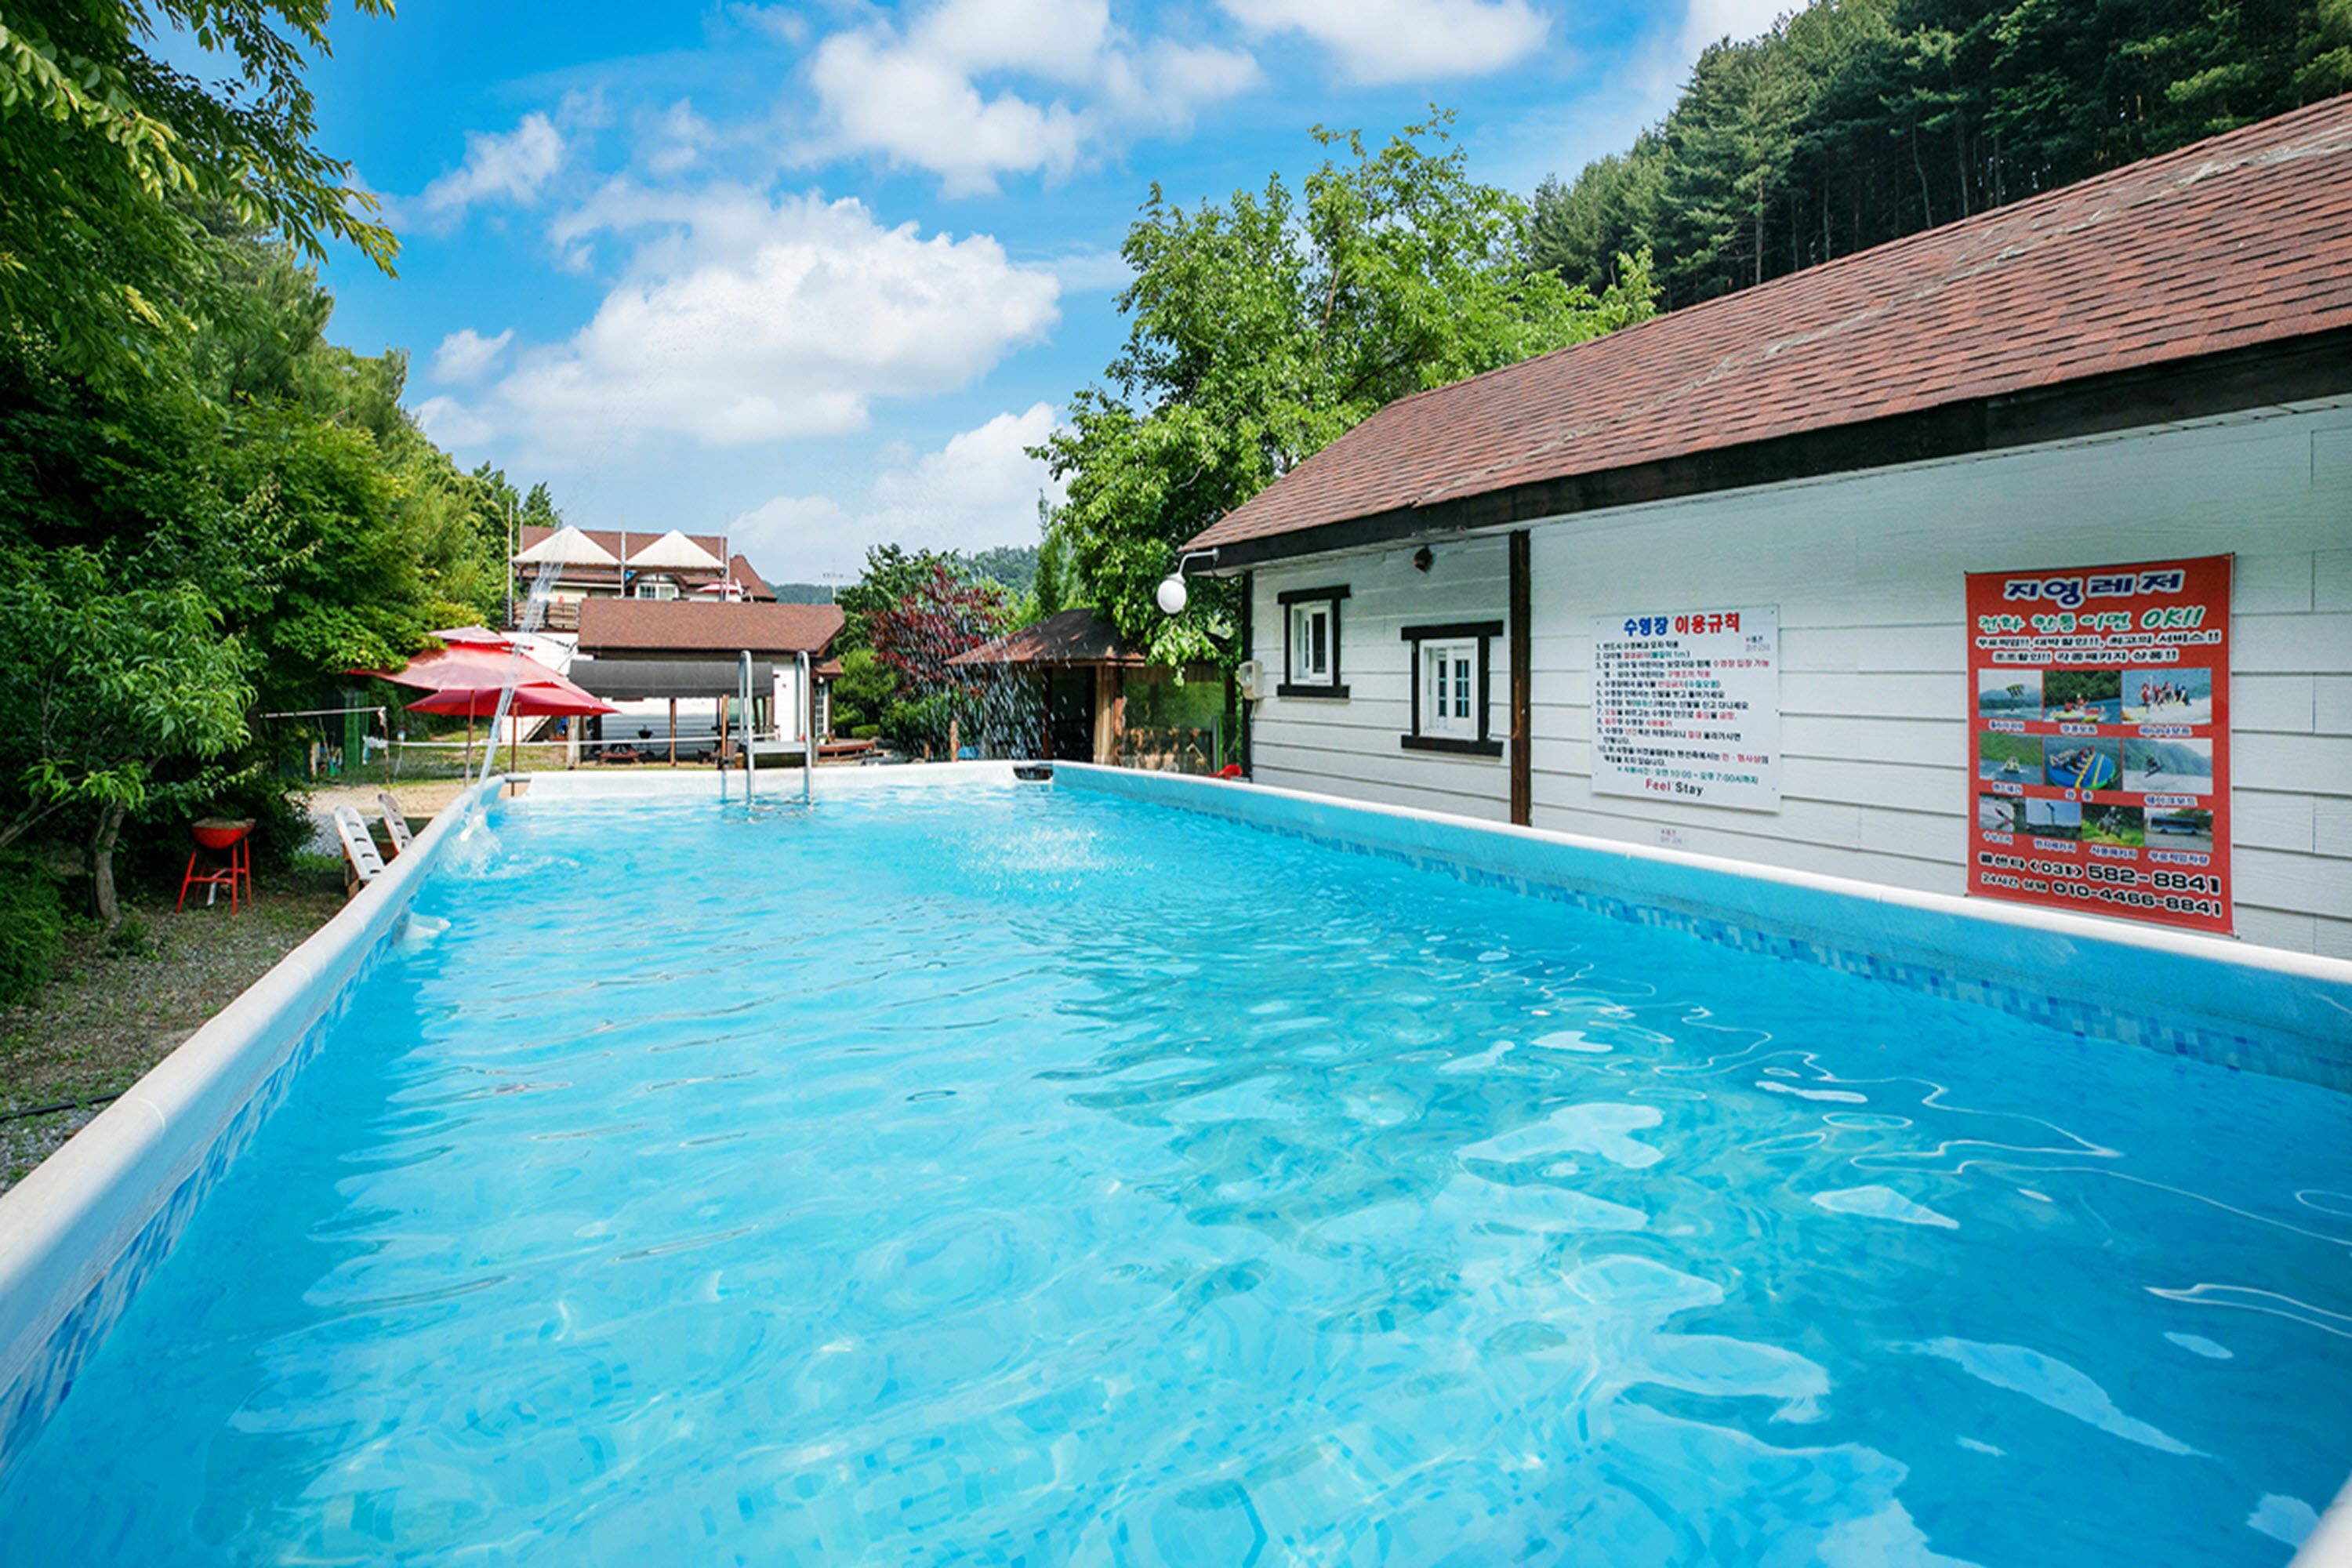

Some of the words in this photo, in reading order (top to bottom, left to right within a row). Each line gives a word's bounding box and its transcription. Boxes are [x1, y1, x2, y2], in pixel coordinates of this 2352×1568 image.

[2003, 569, 2186, 609] 지영레저
[1624, 616, 1668, 637] 수영장
[1675, 612, 1740, 635] 이용규칙
[1977, 614, 2026, 634] 전화
[2140, 604, 2206, 629] OK!!
[2156, 628, 2222, 646] 서비스!!
[1646, 778, 1671, 791] Feel
[1675, 781, 1704, 797] Stay
[2086, 864, 2221, 895] 582-8841
[2052, 881, 2222, 917] 010-4466-8841
